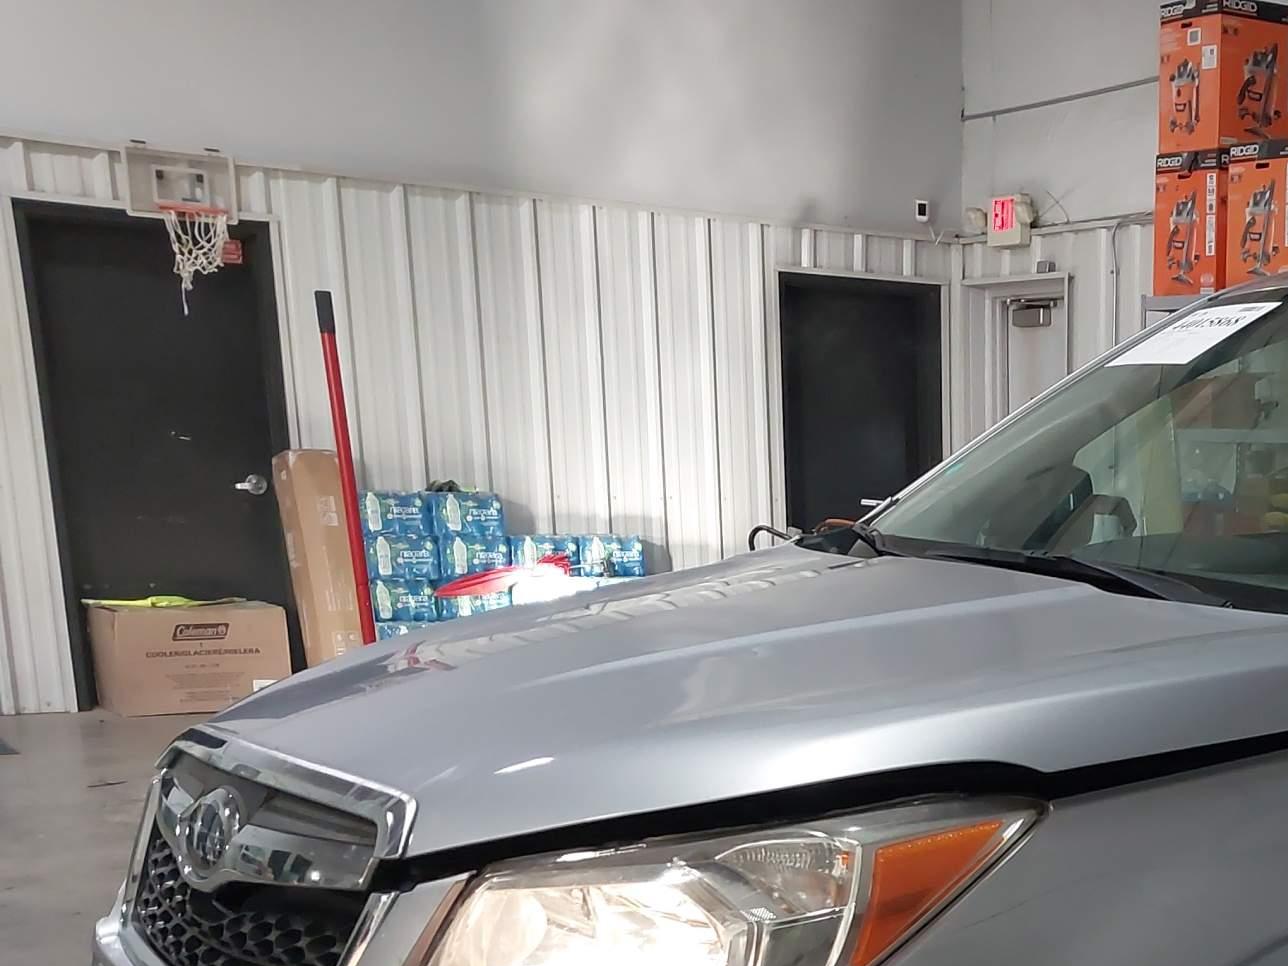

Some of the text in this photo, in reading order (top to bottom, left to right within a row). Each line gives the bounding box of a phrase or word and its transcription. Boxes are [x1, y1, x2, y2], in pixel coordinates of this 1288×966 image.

[1230, 144, 1259, 157] RIDGID
[1157, 156, 1182, 167] RIDGID
[176, 624, 217, 638] Coleman
